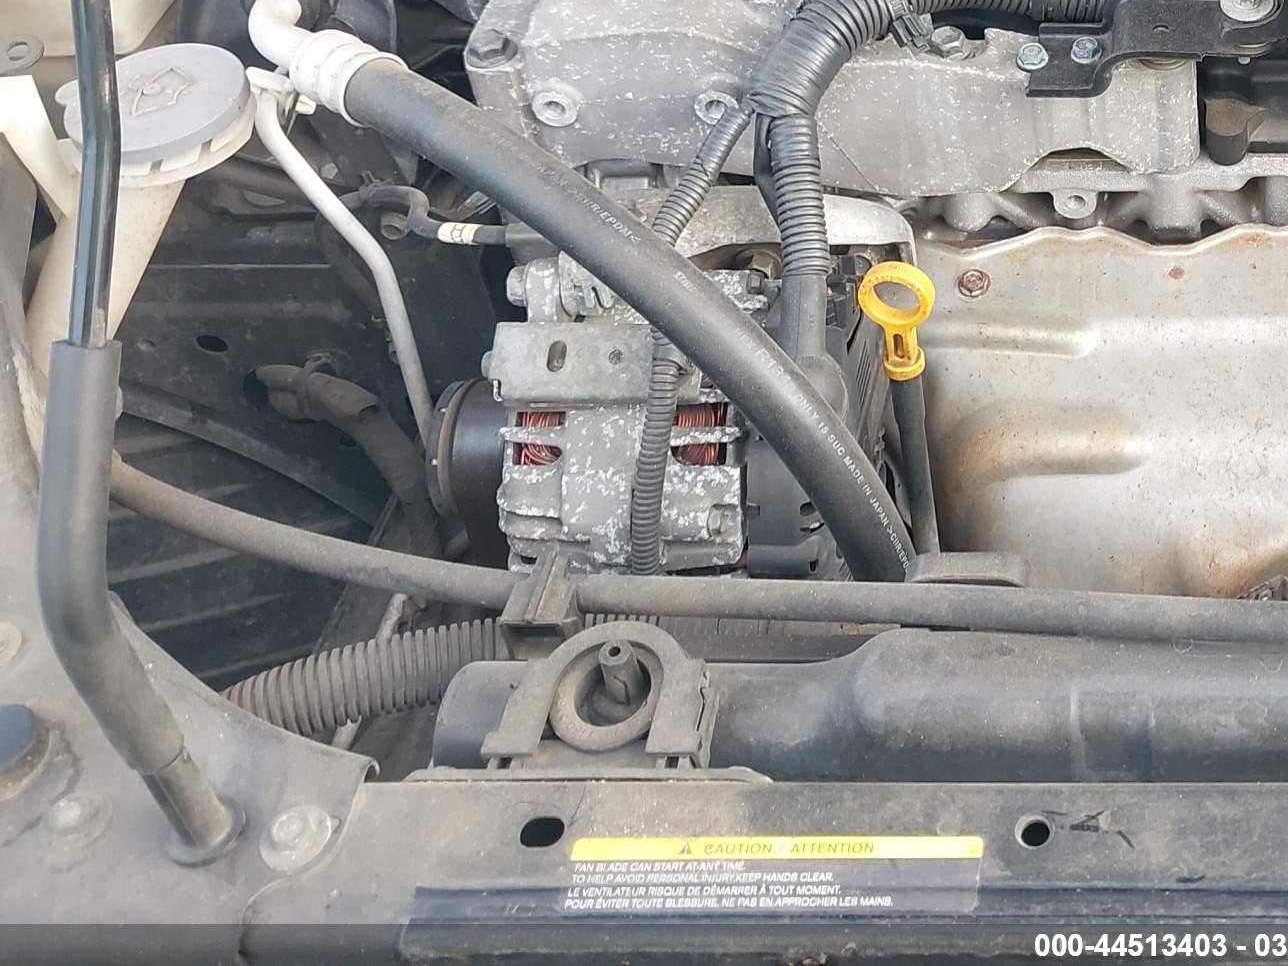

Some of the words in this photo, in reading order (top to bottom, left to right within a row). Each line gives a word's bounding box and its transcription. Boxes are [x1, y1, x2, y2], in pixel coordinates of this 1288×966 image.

[795, 393, 820, 420] ONLY
[827, 434, 846, 457] SUC
[843, 455, 866, 485] MADE
[862, 483, 873, 497] IN
[869, 496, 890, 527] JAPAN
[704, 842, 773, 855] CAUTION
[790, 842, 875, 854] ATTENTION
[574, 862, 595, 872] FAN
[596, 862, 628, 872] BLADE
[629, 862, 651, 872] CAN
[653, 861, 684, 872] START
[571, 874, 586, 884] TO
[586, 874, 614, 884] HELP
[614, 874, 646, 884] AVOID
[646, 873, 700, 884] PERSONAL
[762, 872, 798, 883] HANDS
[800, 872, 834, 882] CLEAR.
[567, 887, 581, 898] LE
[582, 886, 647, 897] VENTILATEUR
[648, 886, 686, 897] RISQUE
[686, 886, 701, 896] DE
[703, 883, 758, 896] DÉMARRER
[768, 885, 795, 896] TOUT
[796, 885, 841, 895] MOMENT.
[565, 898, 595, 910] POUR
[595, 896, 631, 909] ÉVITER
[631, 898, 663, 908] TOUTE
[721, 897, 736, 907] NE
[737, 897, 758, 907] PAS
[759, 896, 774, 907] EN
[774, 896, 838, 907] APPROCHER
[839, 896, 859, 907] LES
[859, 896, 893, 907] MAINS.
